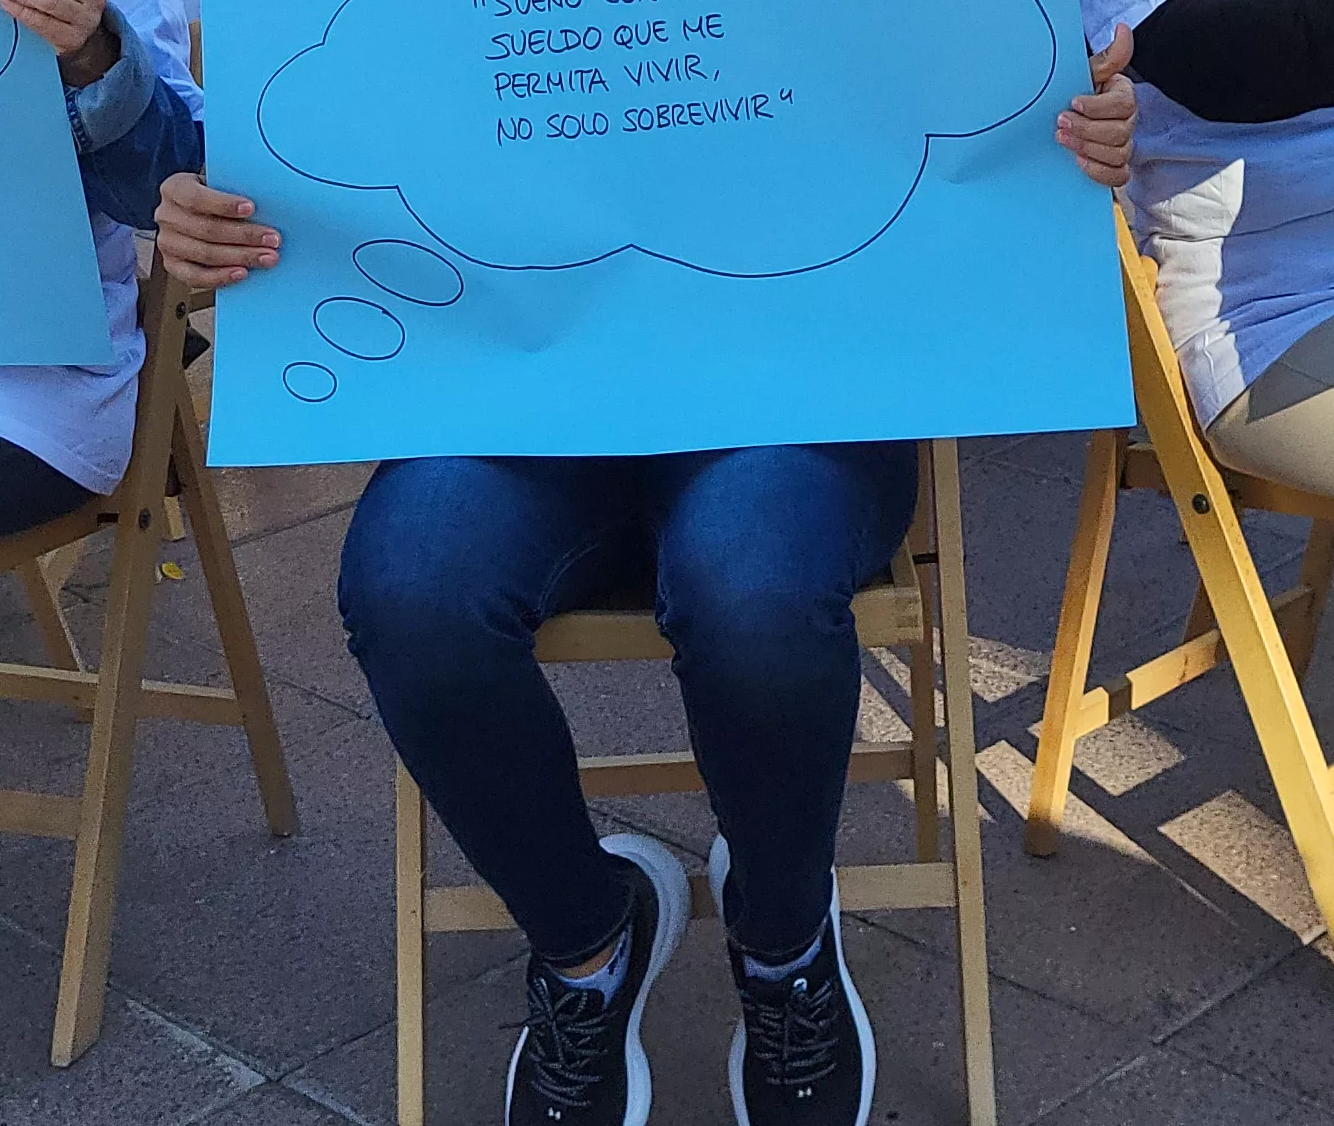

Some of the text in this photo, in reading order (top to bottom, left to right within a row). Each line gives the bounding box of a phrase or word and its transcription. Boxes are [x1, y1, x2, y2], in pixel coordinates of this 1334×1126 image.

[485, 14, 724, 60] SUELDO QUE ME
[494, 55, 719, 101] PERMITA VIVIR,
[498, 117, 532, 147] NO
[547, 113, 608, 139] SOLO
